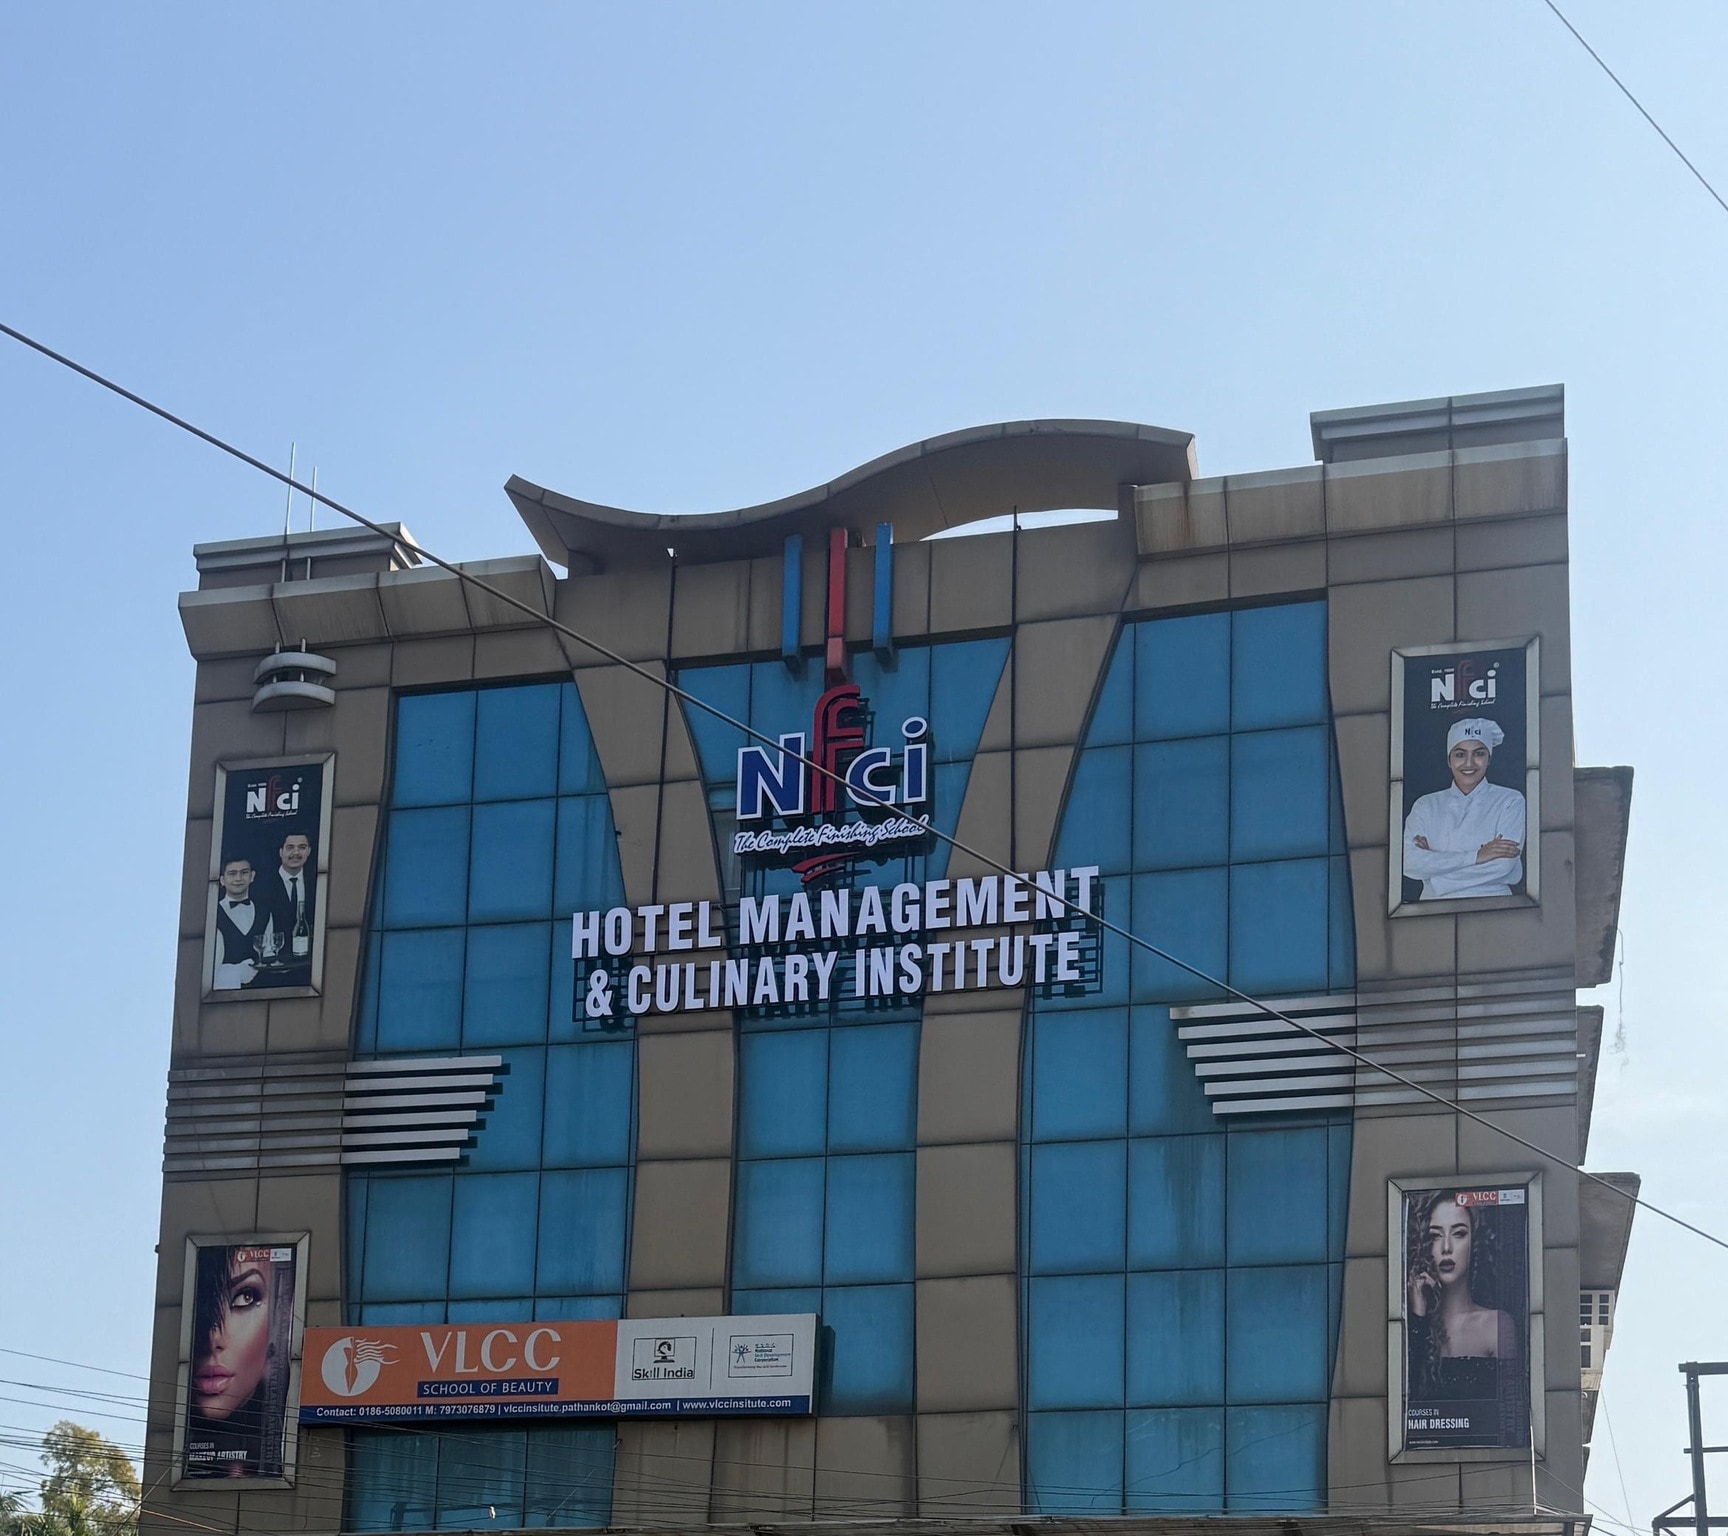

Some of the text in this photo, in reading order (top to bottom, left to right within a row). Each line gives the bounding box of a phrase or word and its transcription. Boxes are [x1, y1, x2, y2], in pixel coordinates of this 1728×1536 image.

[734, 813, 931, 855] The Complete Finishing School
[571, 865, 1100, 959] HOTEL MANAGEMENT
[585, 930, 1081, 1017] & CULINARY INSTITUTE
[420, 1328, 562, 1374] VLCC
[634, 1367, 695, 1380] Skill India
[423, 1381, 553, 1396] SCHOOL OF BEAUTY
[316, 1406, 357, 1417] Contact:
[358, 1405, 422, 1417] 0186-5080011
[425, 1405, 437, 1415] M:
[439, 1404, 496, 1416] 7973076879
[1408, 1417, 1470, 1430] HAIR DRESSING
